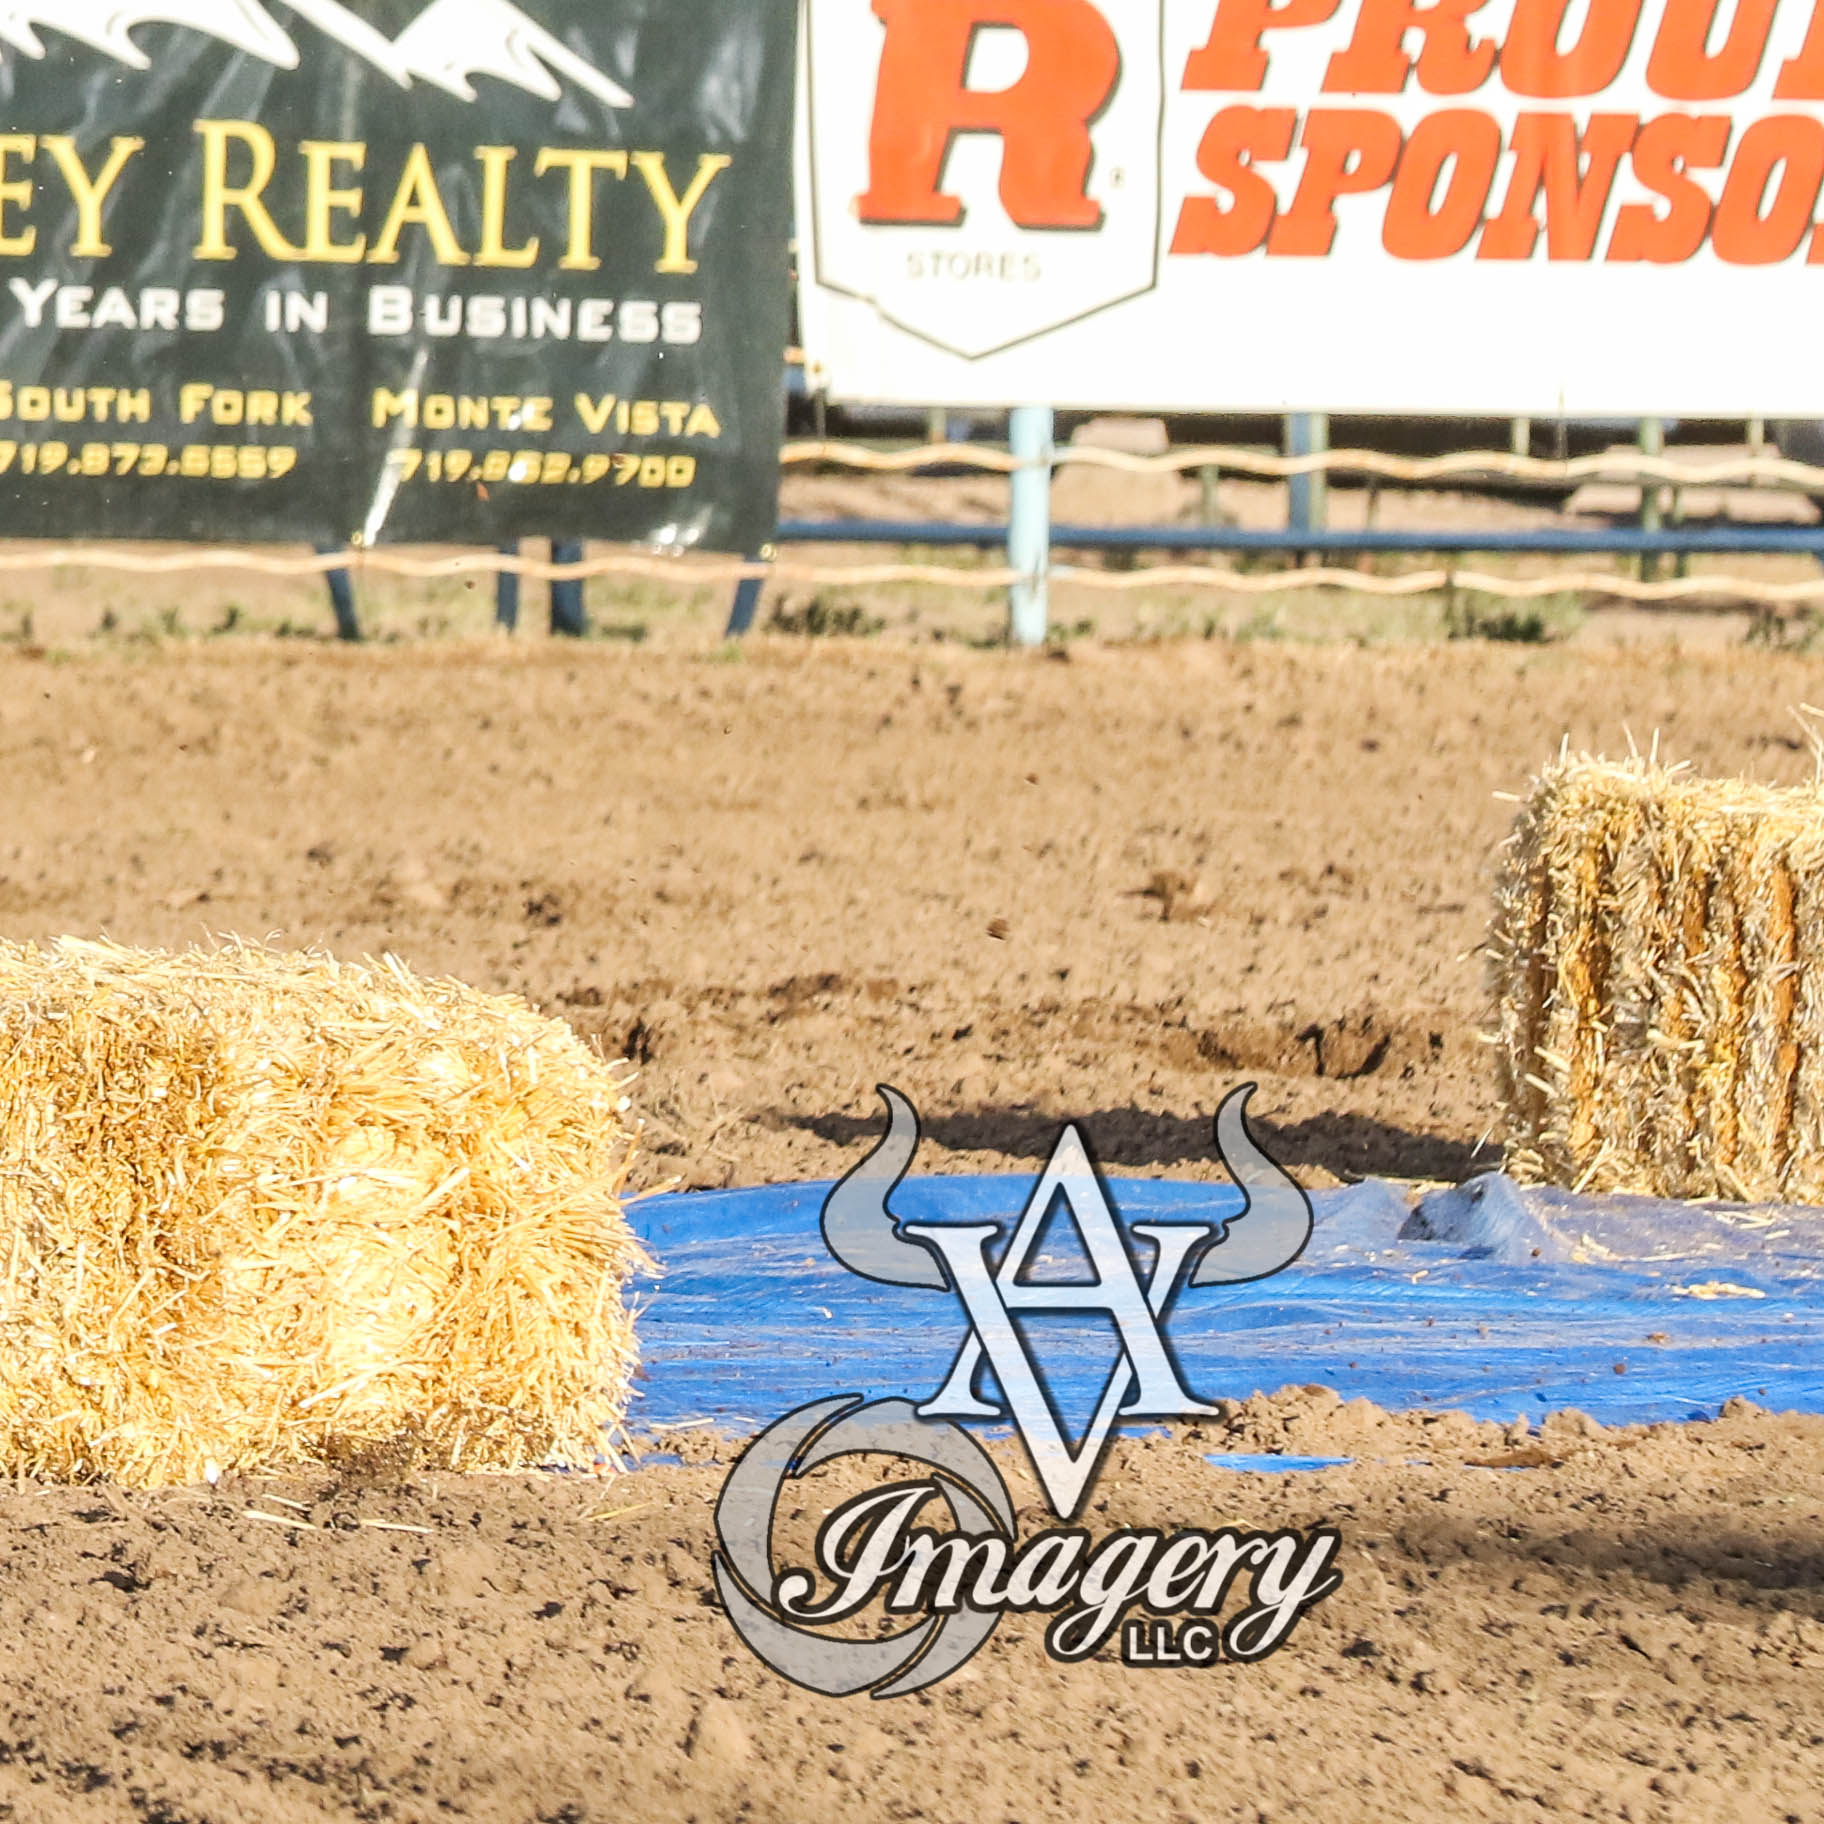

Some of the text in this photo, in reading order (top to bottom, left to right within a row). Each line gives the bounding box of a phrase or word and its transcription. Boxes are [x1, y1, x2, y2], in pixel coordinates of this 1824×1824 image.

[192, 119, 730, 274] REALTY
[1169, 104, 1824, 267] SPONSO
[906, 251, 1042, 281] STORES
[9, 278, 227, 332] YEARS
[266, 289, 330, 333] IN
[367, 286, 704, 344] BUSINESS
[179, 382, 313, 426] FORK
[370, 386, 722, 439] MONTE VISTA
